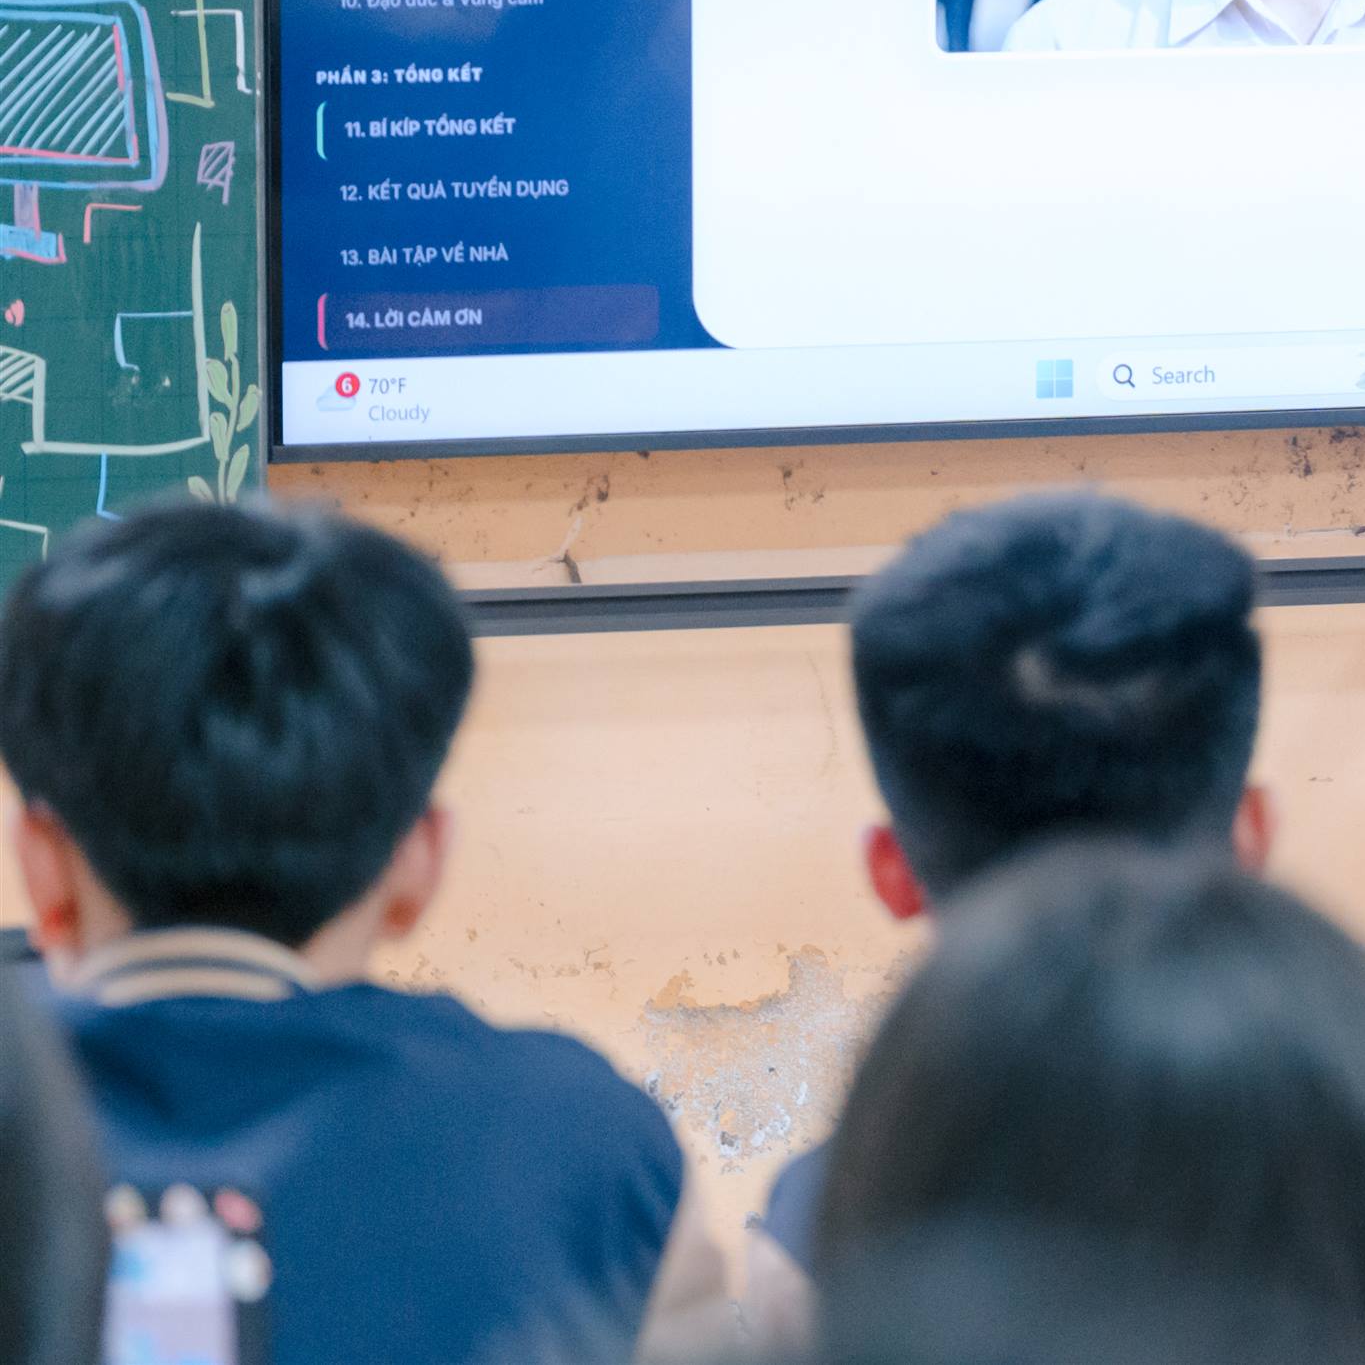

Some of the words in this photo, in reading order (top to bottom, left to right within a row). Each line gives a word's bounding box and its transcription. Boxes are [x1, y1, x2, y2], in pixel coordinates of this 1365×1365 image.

[340, 250, 363, 266] 13.
[368, 246, 397, 265] BÀI
[403, 245, 437, 267] TẬP
[469, 242, 509, 261] NHÀ
[346, 312, 370, 328] 14.
[375, 308, 403, 327] LỜI
[408, 306, 451, 326] CẢM
[455, 309, 482, 325] ƠN
[342, 377, 354, 394] 6
[368, 377, 407, 395] 70°F
[1151, 364, 1216, 387] Search
[368, 404, 430, 424] Cloudy
